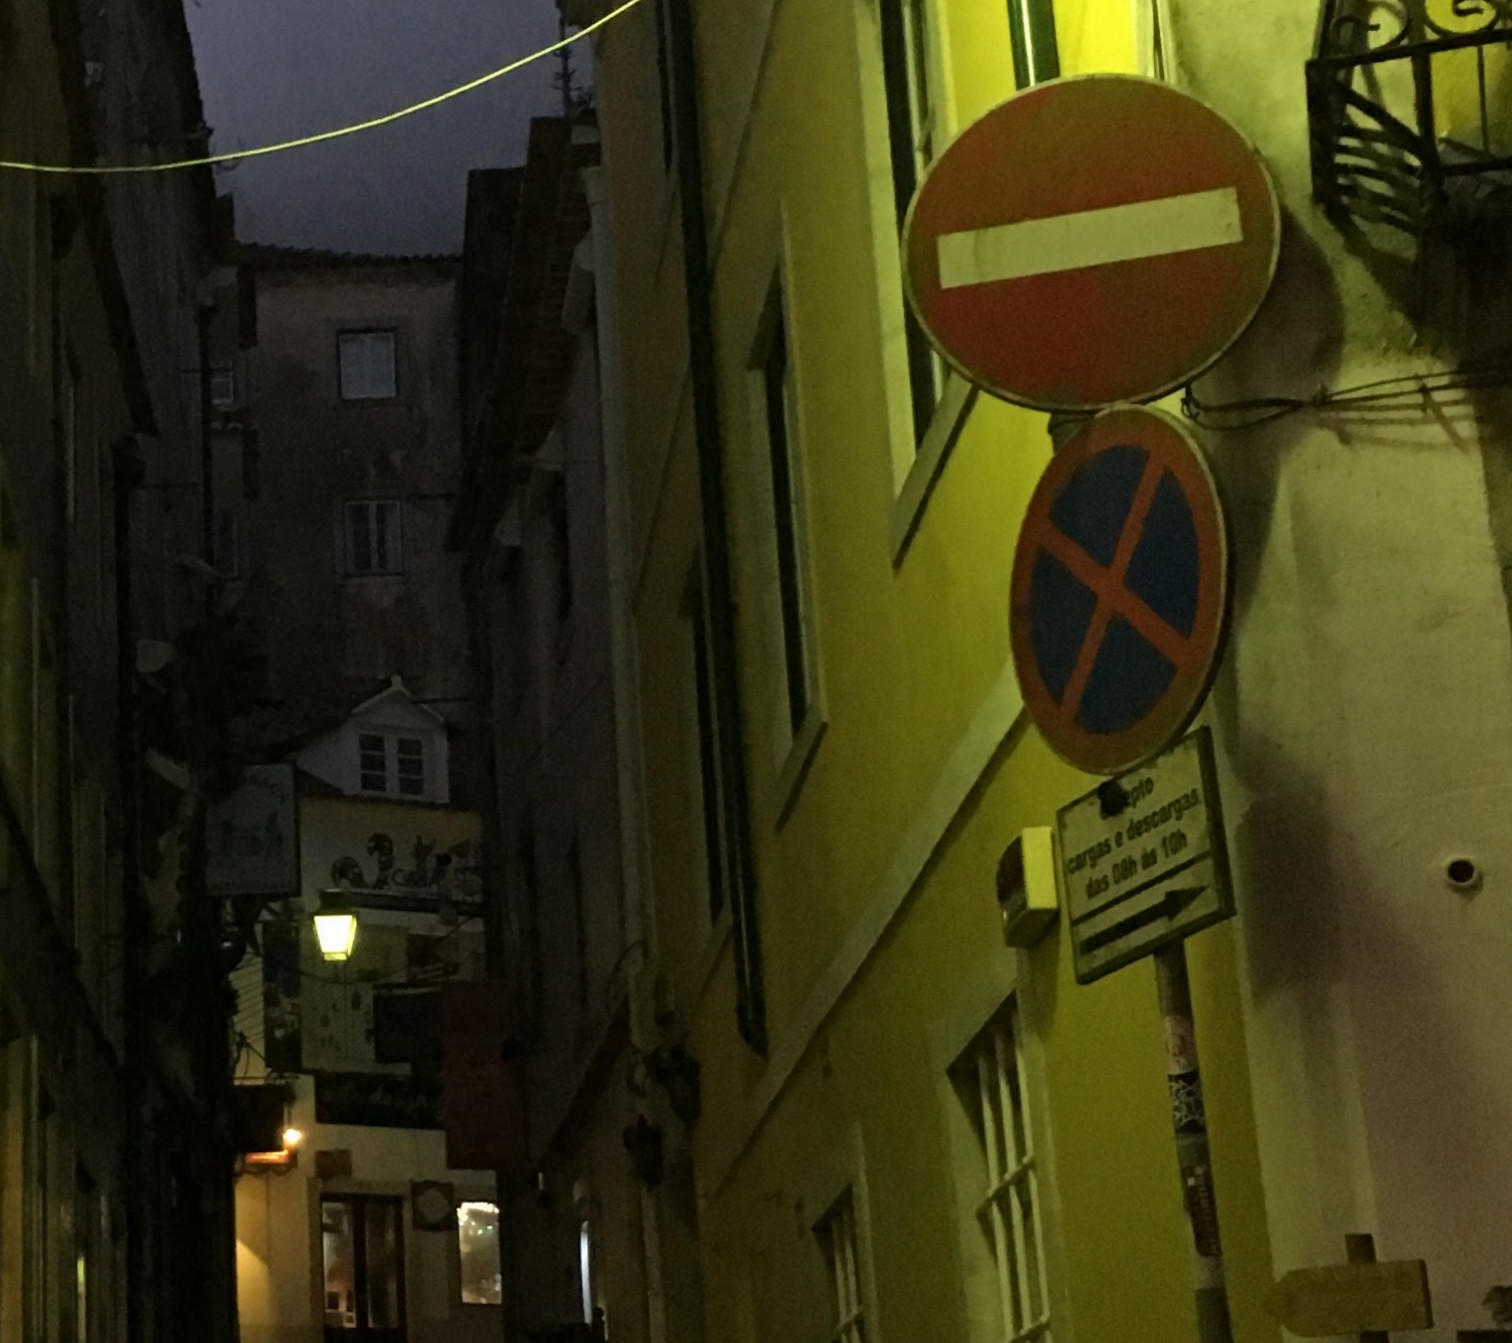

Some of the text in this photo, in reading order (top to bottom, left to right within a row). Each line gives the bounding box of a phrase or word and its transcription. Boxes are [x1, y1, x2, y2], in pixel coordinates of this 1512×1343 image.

[1067, 836, 1112, 874] cargas
[1114, 831, 1124, 848] e
[1126, 787, 1201, 842] descargas
[1086, 873, 1110, 898] das
[1161, 829, 1188, 859] 10h
